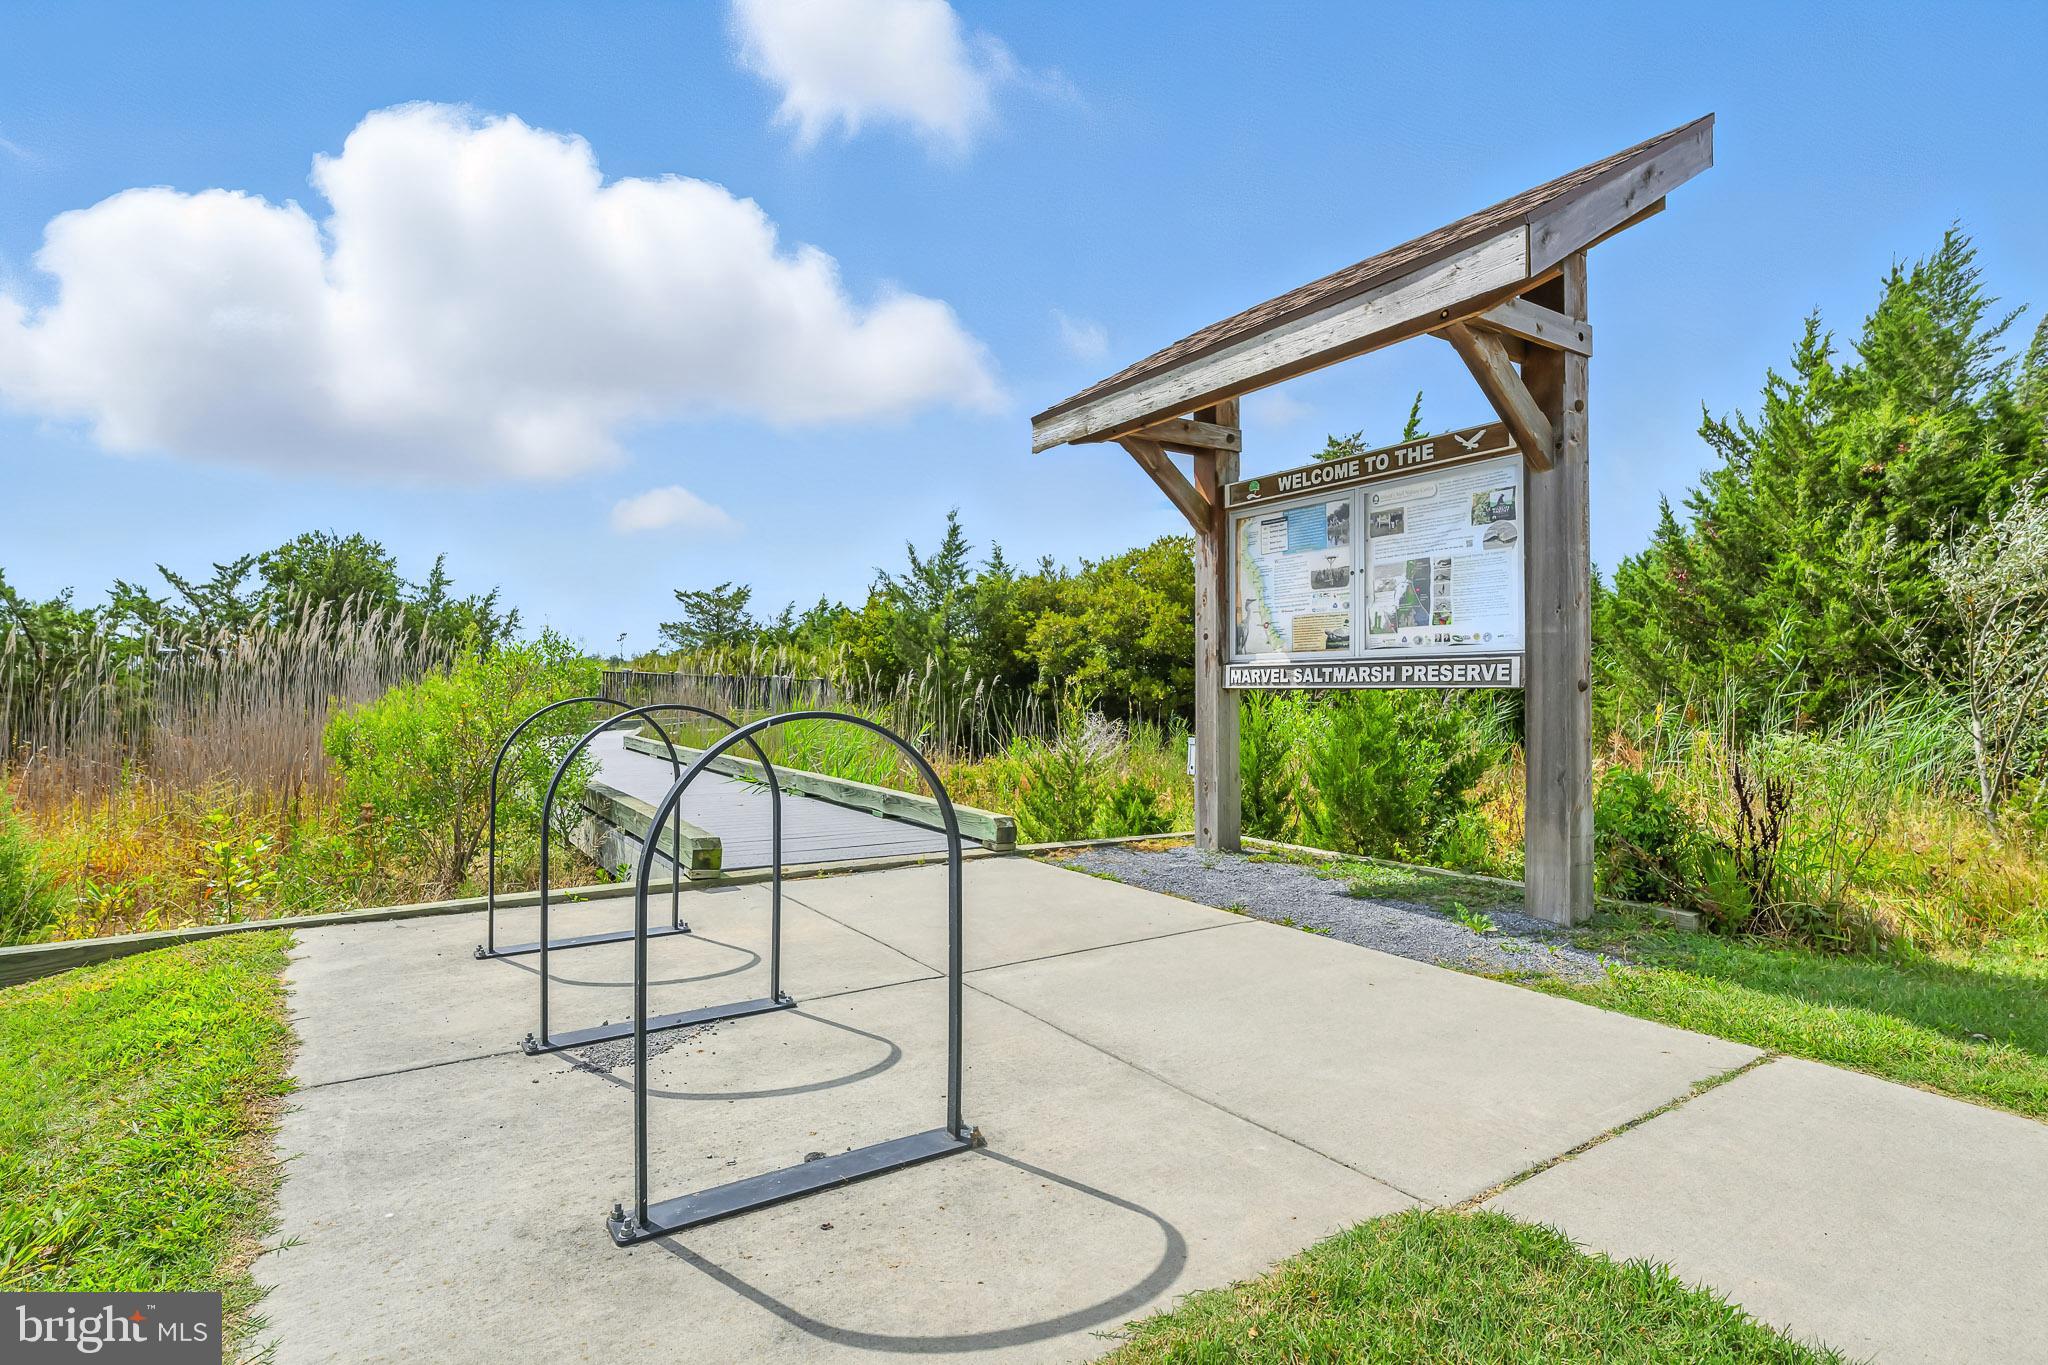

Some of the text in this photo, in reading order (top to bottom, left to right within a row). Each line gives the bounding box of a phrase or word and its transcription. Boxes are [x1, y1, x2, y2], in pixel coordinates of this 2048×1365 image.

[1278, 442, 1435, 492] WELCOME TO THE
[1230, 663, 1511, 684] MARVEL SALTMARSH PRESERVE
